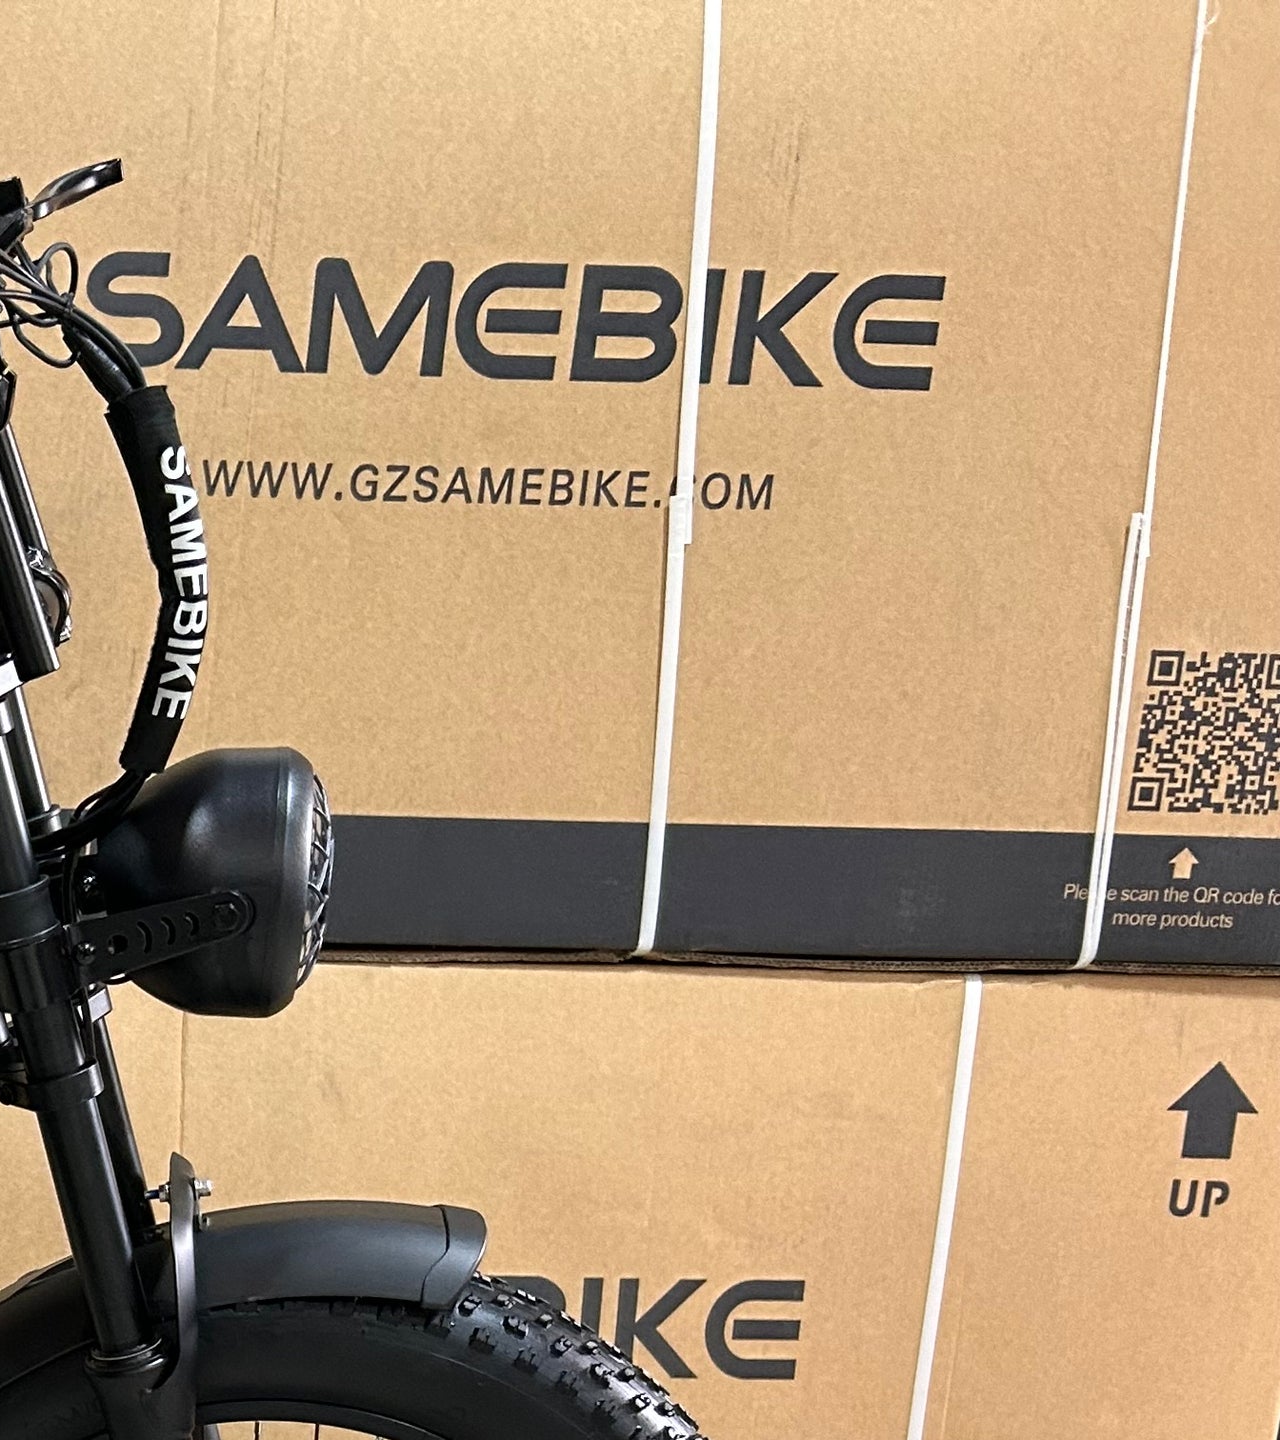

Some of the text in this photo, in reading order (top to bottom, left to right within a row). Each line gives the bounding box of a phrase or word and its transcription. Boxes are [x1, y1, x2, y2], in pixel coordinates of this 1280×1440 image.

[87, 251, 946, 392] SAMEBIKE
[202, 458, 775, 511] WWW.GZSAMEBIKE.OM
[151, 445, 209, 720] SAMEBIKE
[1063, 883, 1280, 906] Plee scan the QR code fo
[1112, 911, 1234, 930] more products
[1167, 1178, 1231, 1219] UP
